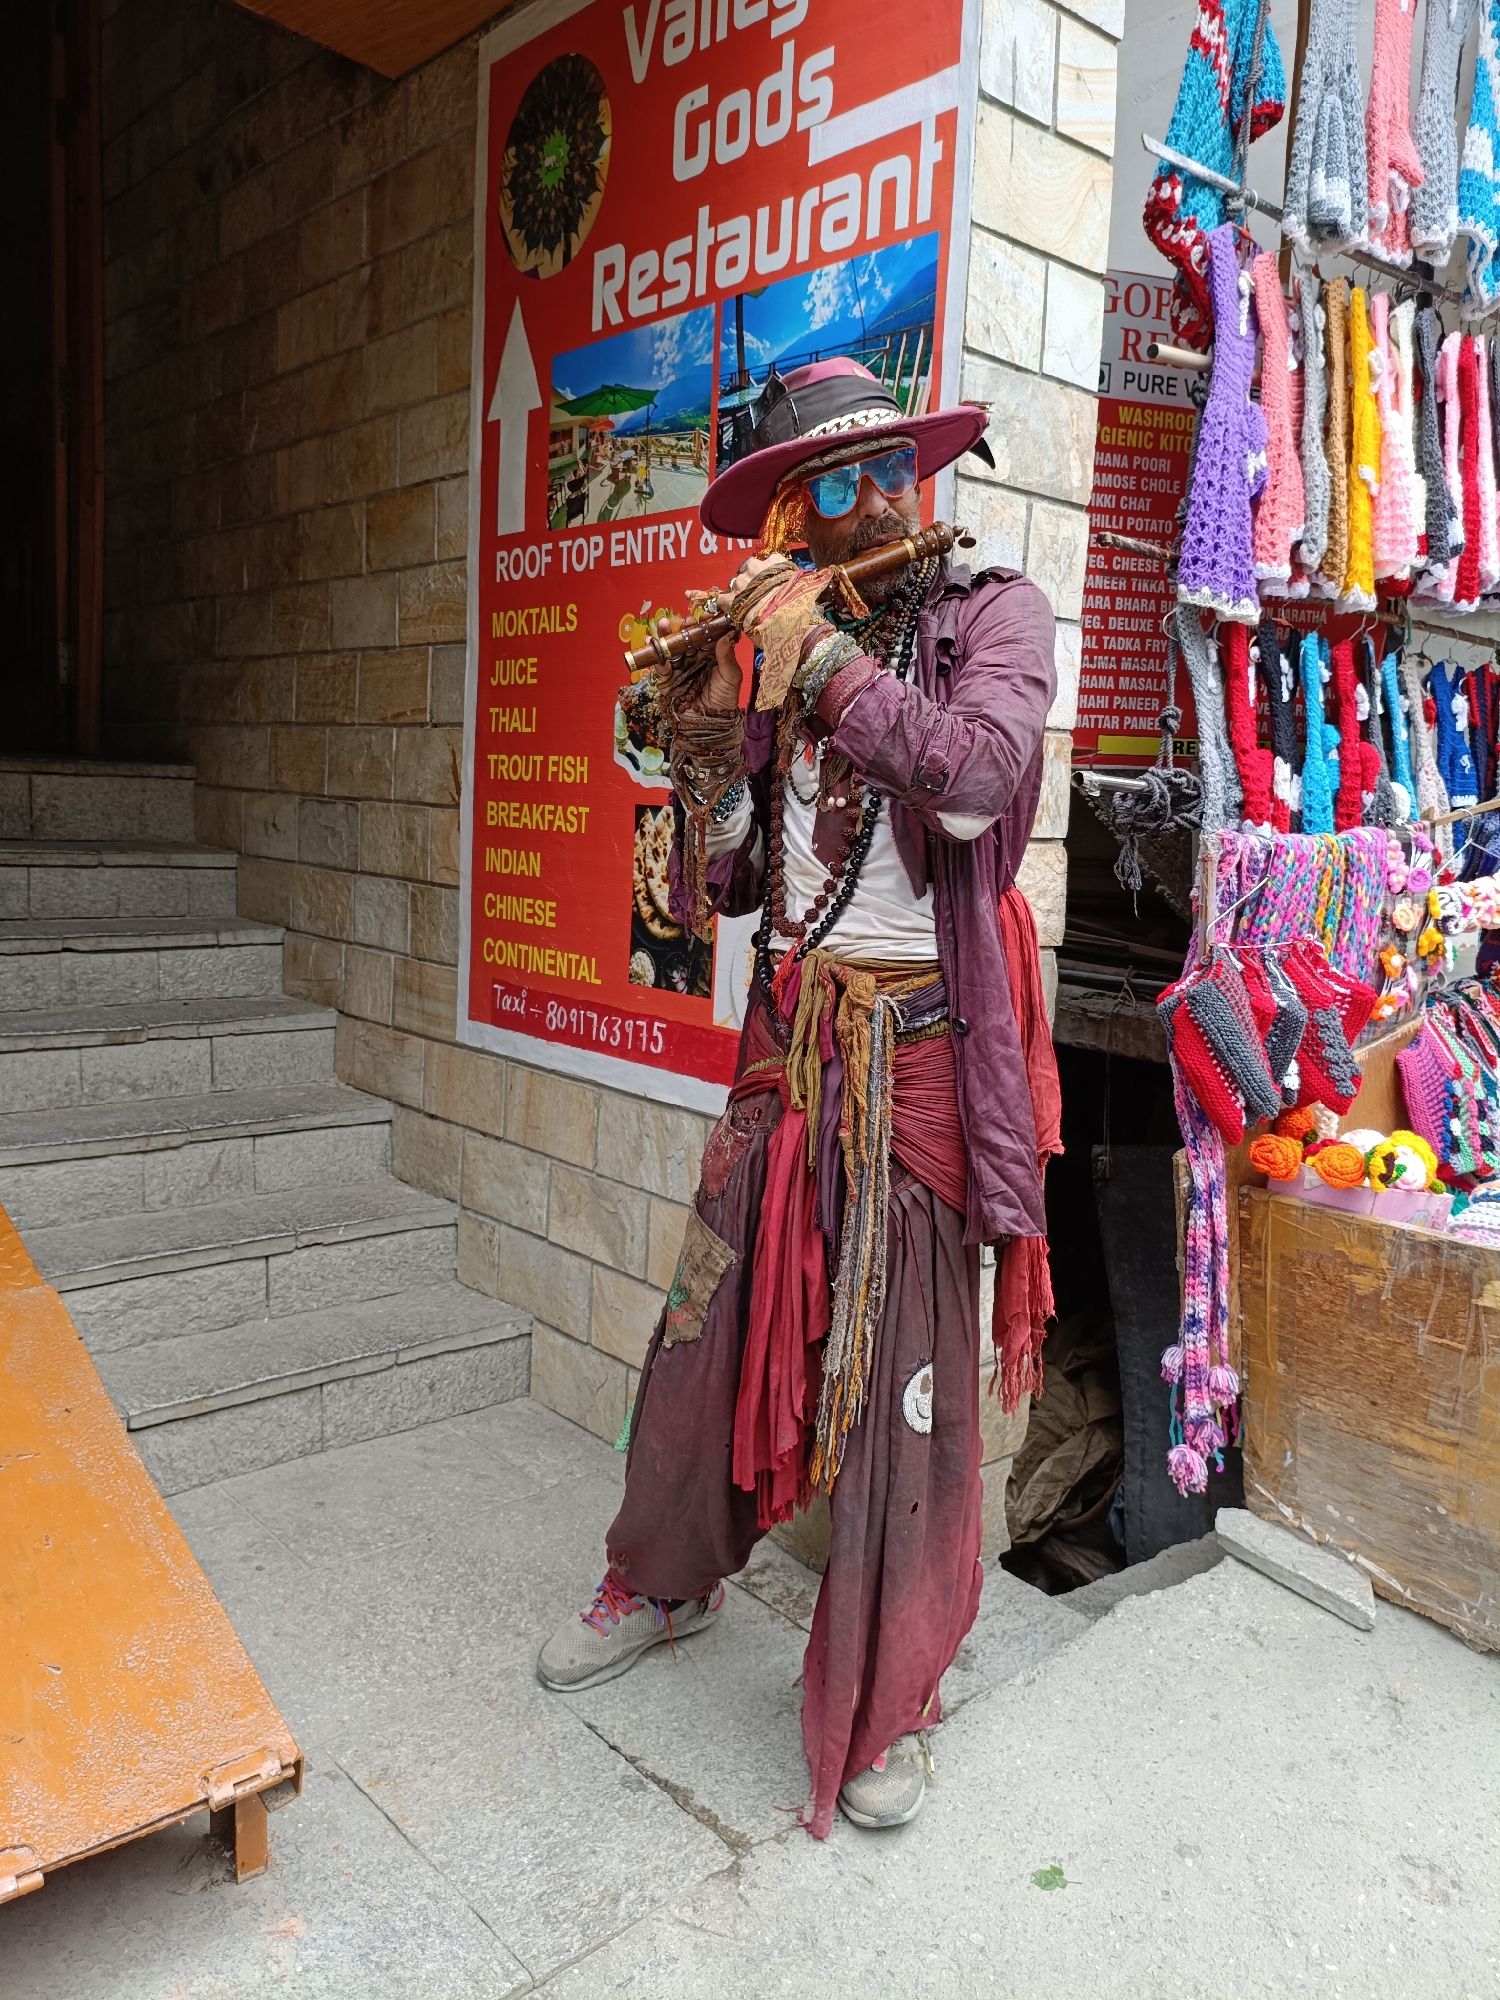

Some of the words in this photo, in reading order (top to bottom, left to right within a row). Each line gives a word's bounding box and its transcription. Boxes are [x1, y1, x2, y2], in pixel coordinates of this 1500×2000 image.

[673, 40, 835, 182] Gods
[592, 115, 943, 332] Restaurant
[1123, 371, 1178, 396] PURE
[1132, 456, 1171, 473] POORI
[1140, 477, 1180, 494] CHOLE
[1119, 495, 1152, 512] CHAT
[1089, 513, 1123, 530] HILLI
[1126, 517, 1173, 534] POTATO
[496, 543, 552, 582] ROOF
[559, 535, 604, 574] TOP
[610, 520, 693, 567] ENTRY
[1087, 554, 1108, 569] EG.
[1112, 556, 1160, 573] CHEESE
[1130, 578, 1165, 594] TIKKA
[1115, 597, 1156, 613] BHARA
[1277, 607, 1327, 624] PARATHA
[492, 603, 578, 638] MOKTAILS
[1108, 616, 1153, 633] DELUXE
[1102, 636, 1141, 651] TADKA
[1145, 639, 1168, 653] FRY
[490, 657, 538, 686] JUICE
[1120, 657, 1168, 672] MASALA
[1079, 675, 1115, 690] HANA
[1118, 676, 1167, 692] MASALA
[1113, 696, 1160, 711] PANEER
[489, 707, 537, 733] THALI
[487, 754, 544, 782] TROUT
[547, 756, 589, 784] FISH
[486, 801, 590, 834] BREAKFAST
[485, 847, 541, 877] INDIAN
[484, 893, 557, 928] CHINESE
[483, 937, 602, 985] CONTINENTAL
[493, 983, 527, 1016] Taxi
[545, 1001, 667, 1054] 8091763975
